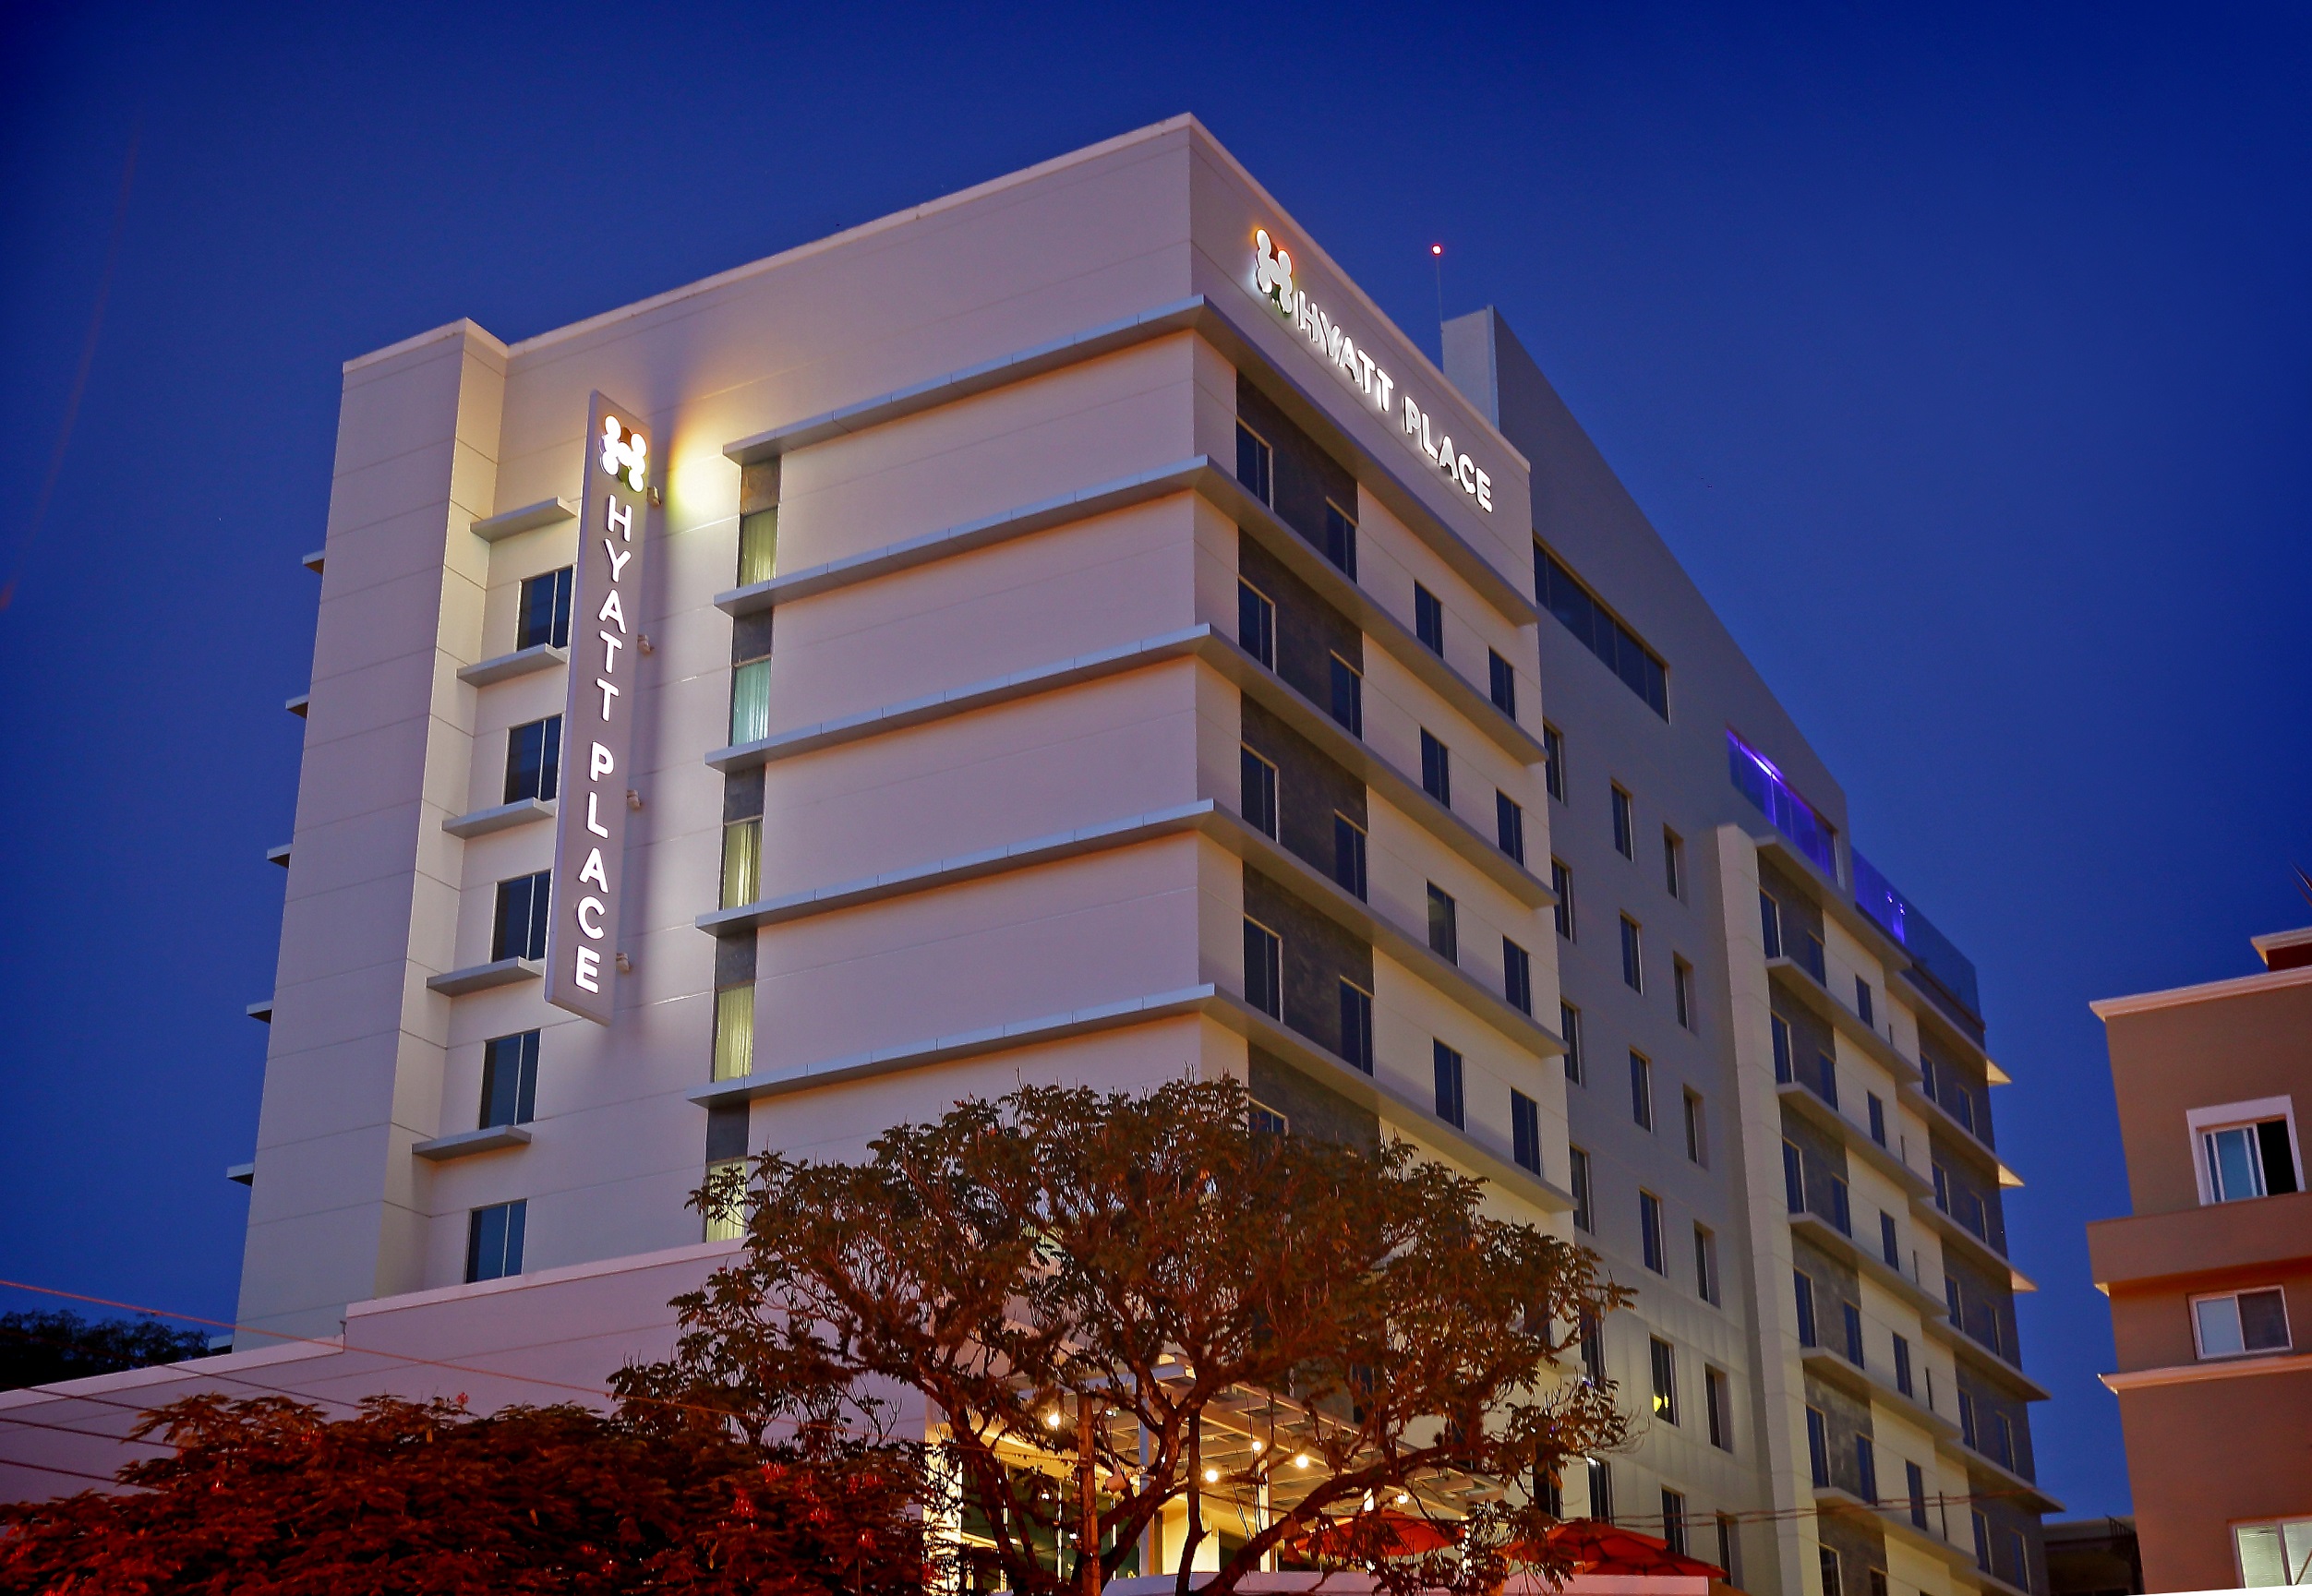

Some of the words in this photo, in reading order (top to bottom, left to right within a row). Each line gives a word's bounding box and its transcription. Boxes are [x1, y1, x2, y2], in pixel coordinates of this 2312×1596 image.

[1296, 291, 1394, 412] HYATT
[1403, 396, 1493, 513] PLACE
[596, 494, 633, 722] HYATT
[574, 739, 615, 994] PLACE
